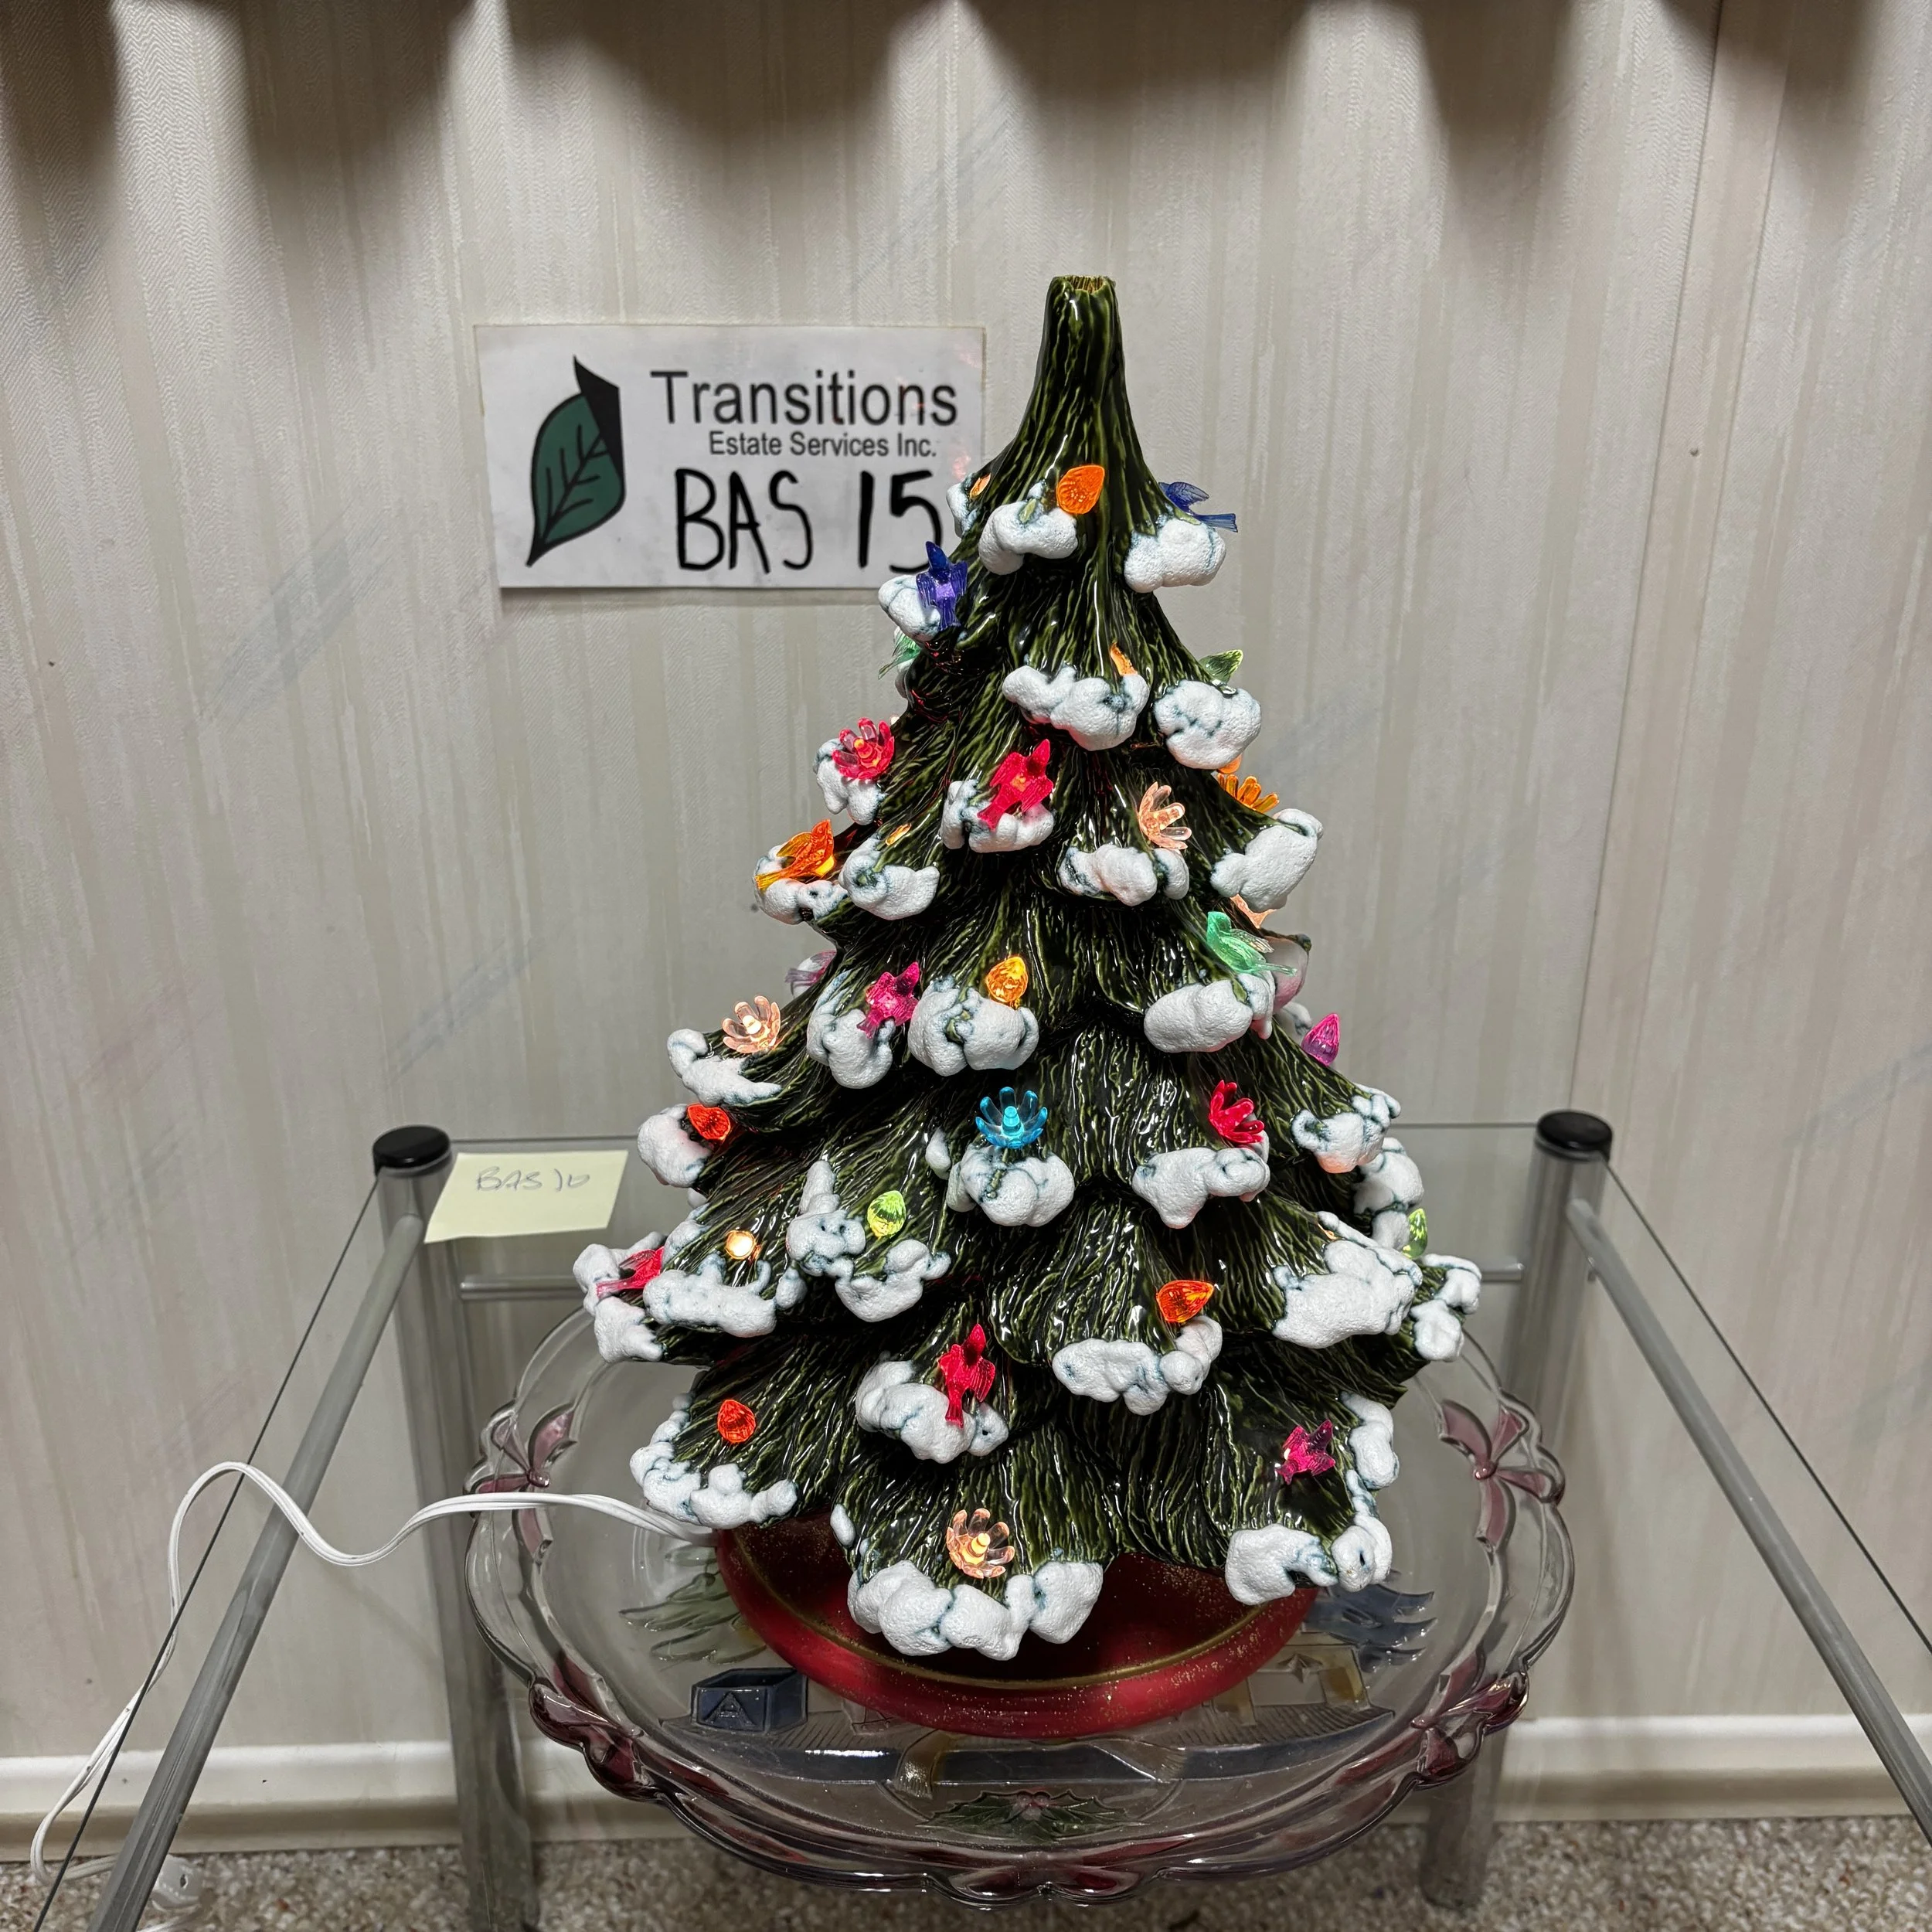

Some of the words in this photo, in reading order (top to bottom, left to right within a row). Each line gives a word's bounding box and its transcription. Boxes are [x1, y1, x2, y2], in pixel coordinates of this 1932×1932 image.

[650, 370, 957, 426] Transitions
[709, 431, 782, 457] Estate
[789, 431, 889, 457] Services
[897, 432, 937, 457] Inc.
[675, 468, 814, 574] BAS
[857, 470, 942, 573] 15
[476, 1166, 543, 1192] BAS
[704, 1691, 755, 1727] A
